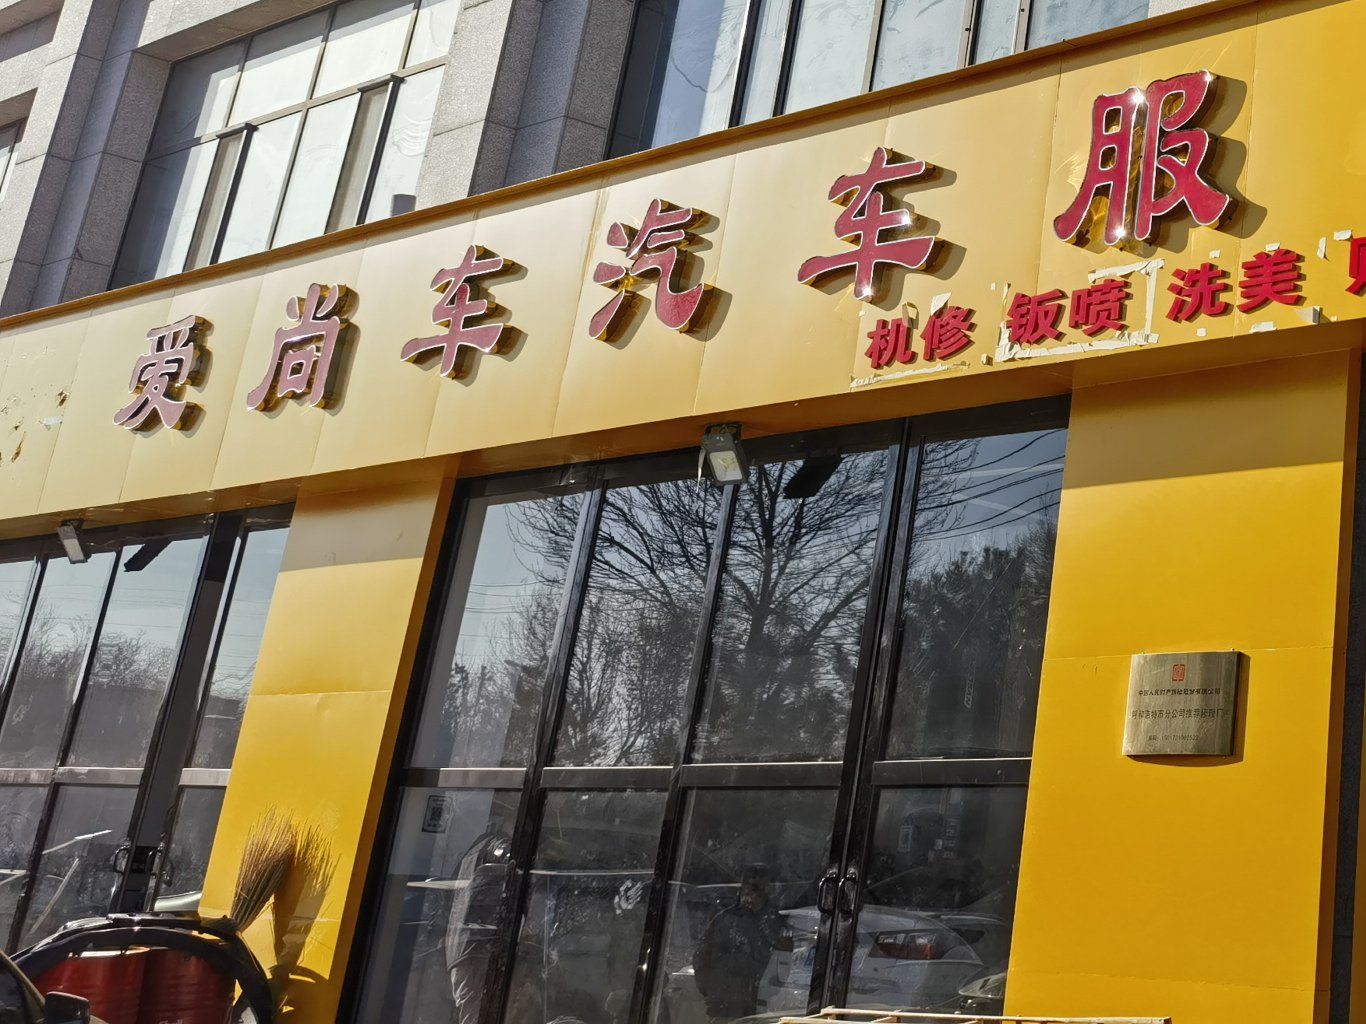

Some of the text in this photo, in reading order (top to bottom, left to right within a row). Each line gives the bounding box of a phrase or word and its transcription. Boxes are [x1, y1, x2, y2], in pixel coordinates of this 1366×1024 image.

[866, 306, 975, 370] 机修
[1007, 279, 1131, 345] 钣喷
[1168, 249, 1303, 322] 洗美
